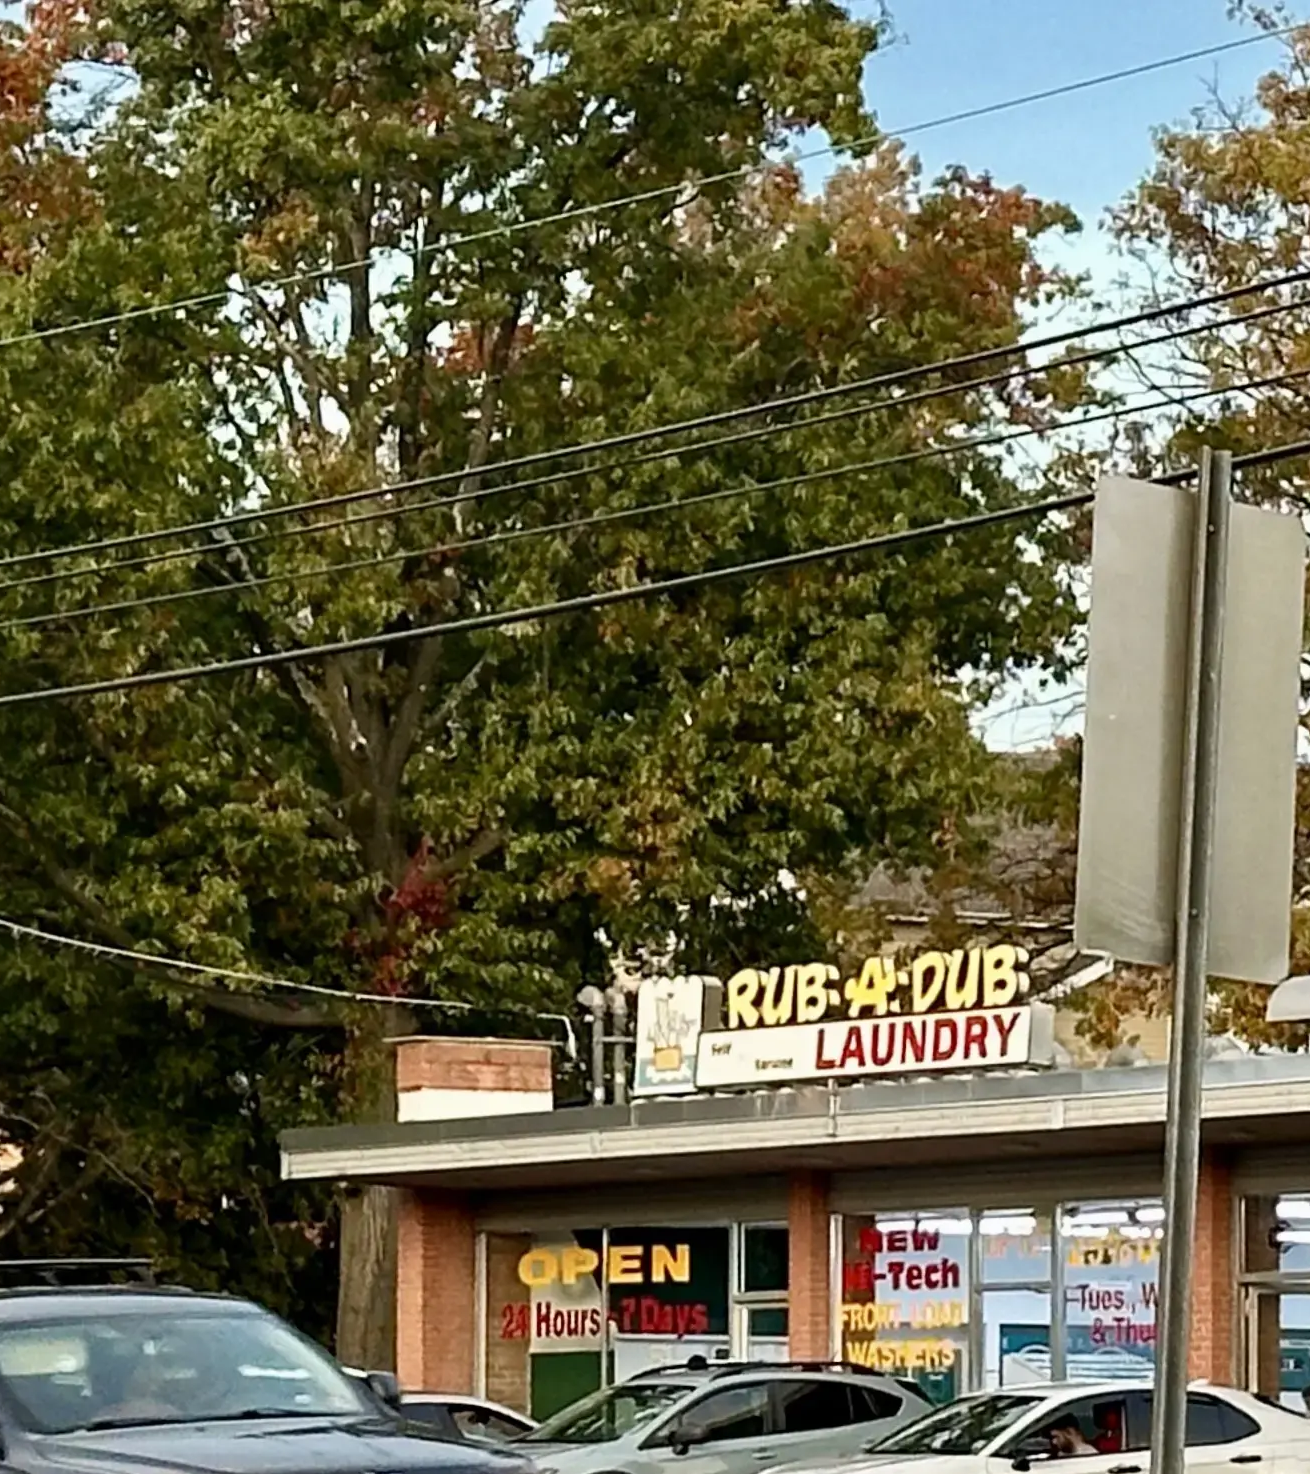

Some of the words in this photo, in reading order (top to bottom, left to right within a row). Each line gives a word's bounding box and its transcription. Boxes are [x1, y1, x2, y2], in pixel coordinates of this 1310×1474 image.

[815, 1011, 1021, 1071] LAUNDRY
[858, 1228, 940, 1253] NEW
[517, 1243, 691, 1287] OPEN
[535, 1301, 602, 1338] Hours
[640, 1295, 709, 1340] Days
[1091, 1317, 1107, 1345] &
